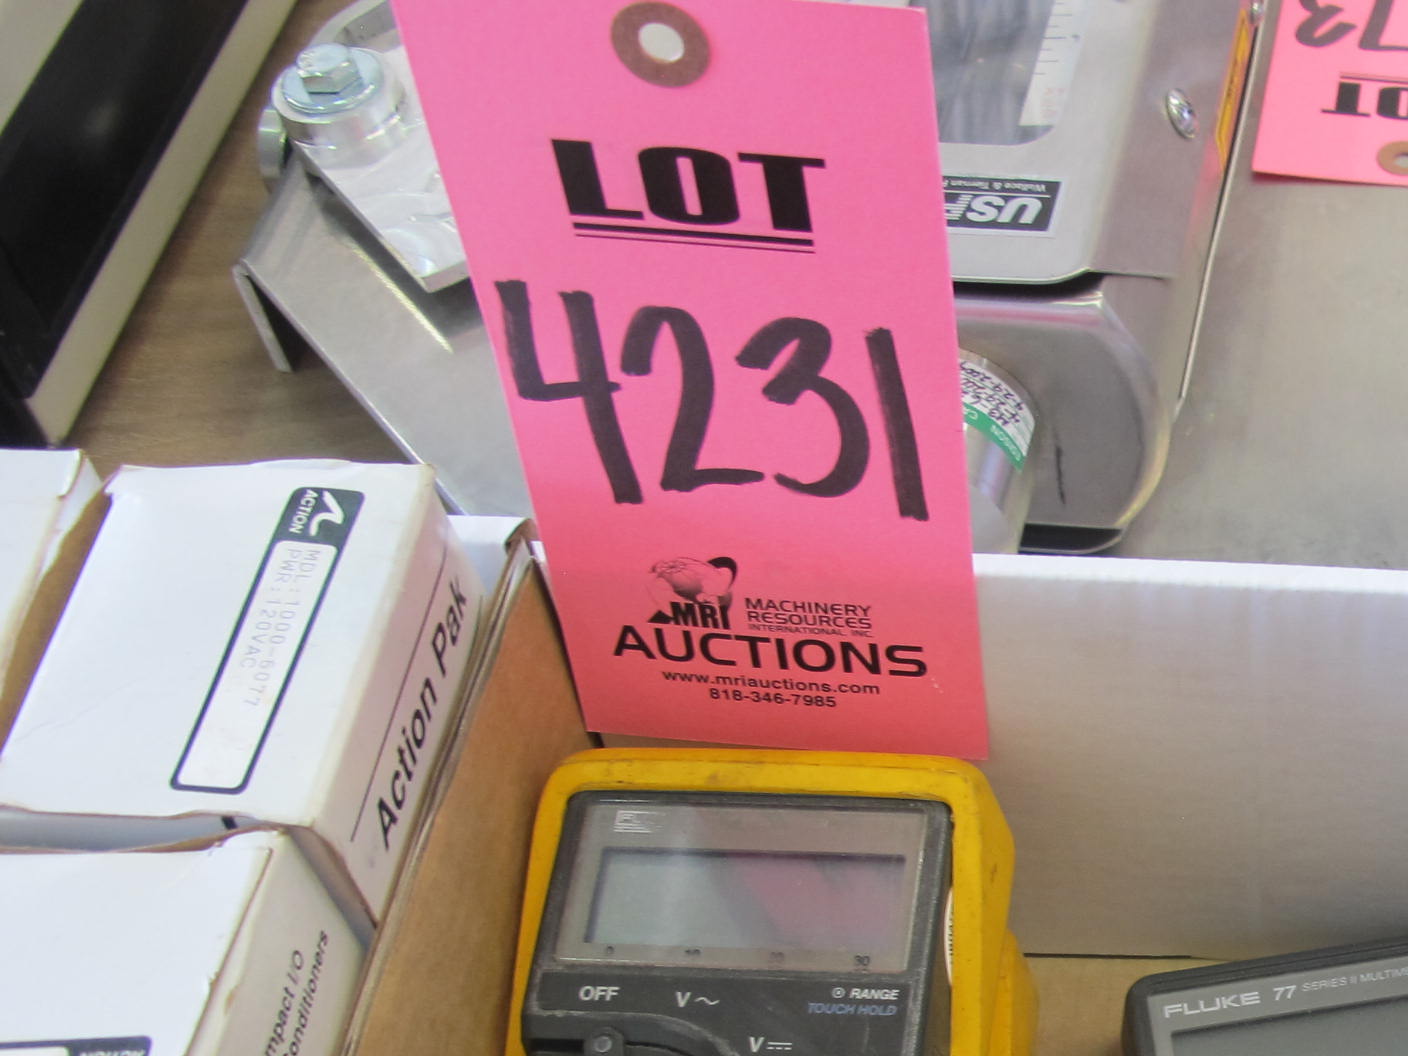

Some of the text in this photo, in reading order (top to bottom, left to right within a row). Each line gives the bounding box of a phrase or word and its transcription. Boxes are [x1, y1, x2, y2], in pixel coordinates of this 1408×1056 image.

[551, 139, 826, 233] LOT
[494, 279, 928, 521] 4231
[288, 489, 318, 534] ACTION
[668, 600, 732, 630] MRI
[745, 597, 871, 618] MACHINERY
[747, 611, 872, 630] RESOURCES
[613, 625, 927, 677] AUCTIONS
[662, 671, 880, 694] www.mriauctions.com
[710, 688, 836, 708] 818-346-7985
[378, 574, 467, 851] Action Pak
[579, 985, 620, 1002] OFF
[849, 987, 899, 1001] RANGE
[1163, 990, 1261, 1019] FLUKE
[1273, 983, 1297, 1002] 77
[1301, 976, 1347, 993] SERIES
[808, 1002, 897, 1016] TOUCH HOLD
